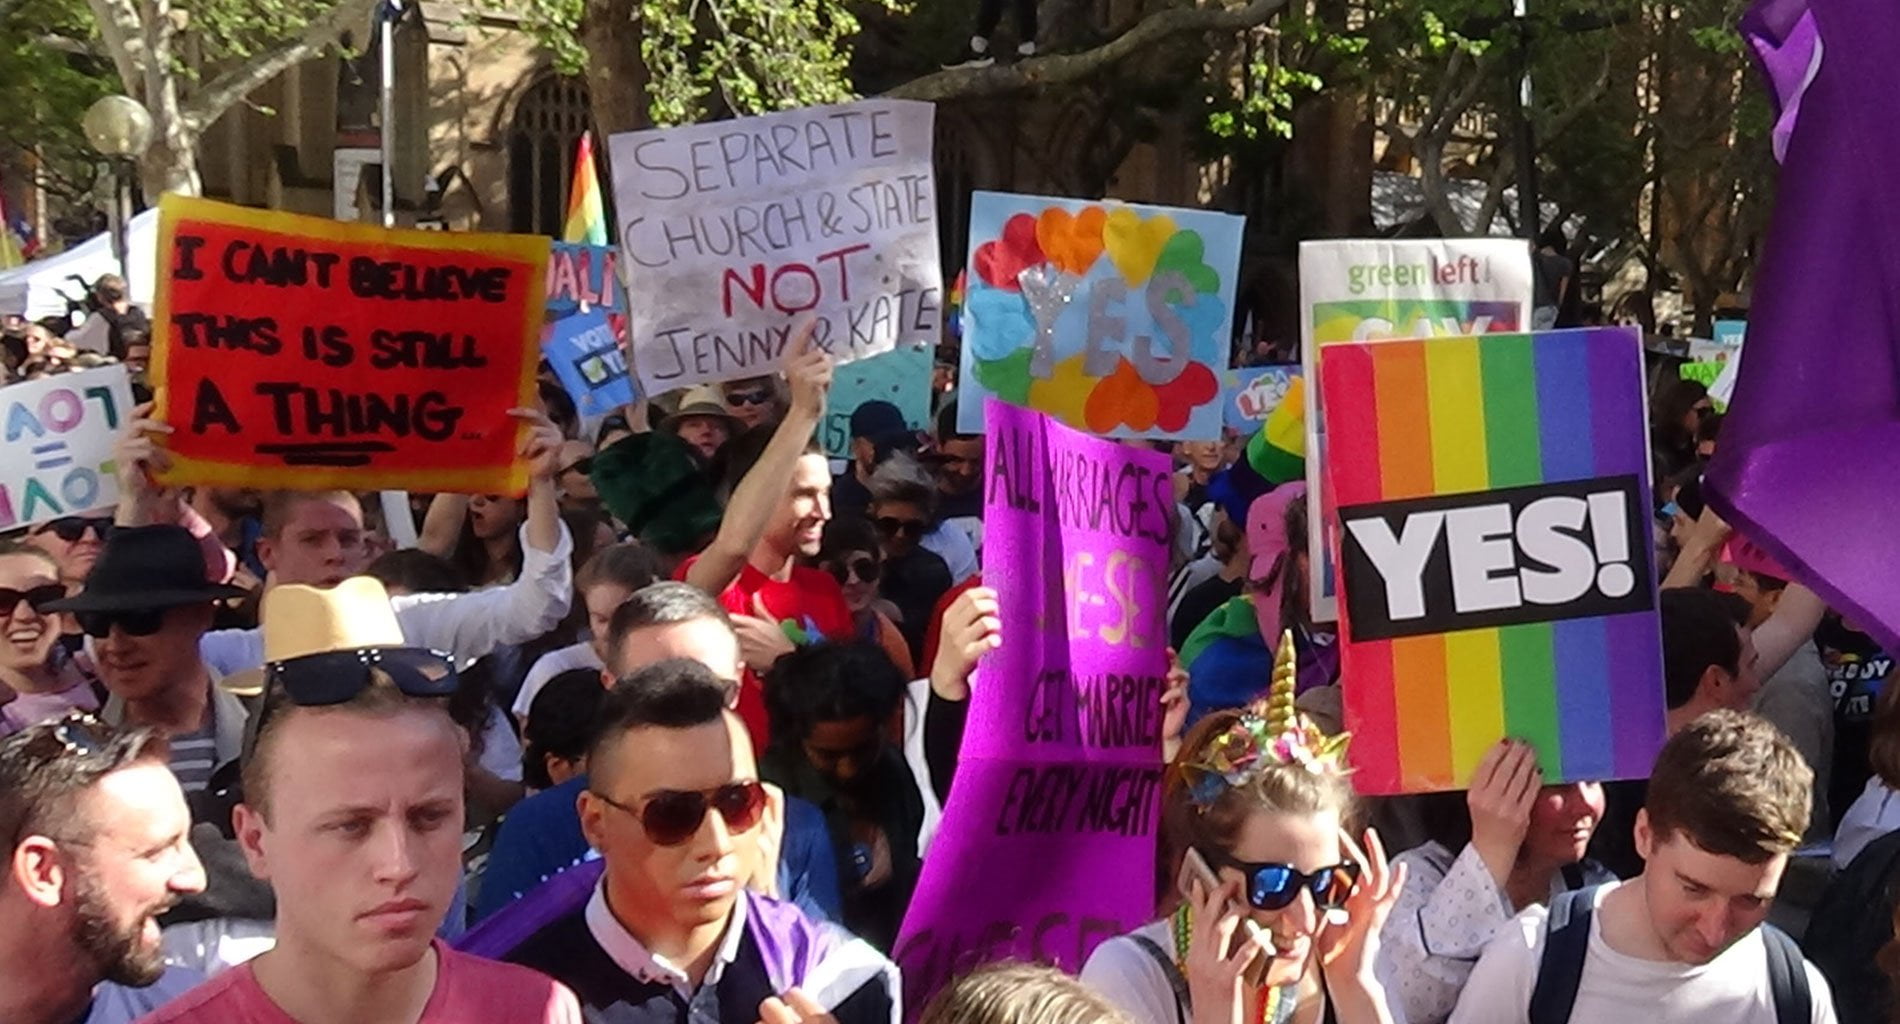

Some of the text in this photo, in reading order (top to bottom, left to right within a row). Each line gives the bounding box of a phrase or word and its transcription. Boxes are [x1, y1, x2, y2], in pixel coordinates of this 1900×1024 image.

[634, 110, 897, 200] SEPARATE
[624, 174, 931, 268] CHURCH & STATE
[173, 235, 206, 281] I
[350, 256, 512, 302] BELIEVE
[722, 243, 871, 318] NOT
[1348, 262, 1426, 294] green
[171, 312, 489, 369] THIS IS STILL
[653, 324, 791, 380] JENNY
[847, 287, 939, 345] KATE
[1017, 261, 1196, 386] YES
[191, 376, 242, 434] A
[988, 426, 1040, 514] ALL
[1345, 490, 1636, 622] YES!
[996, 766, 1161, 837] EVERY NIGHT
